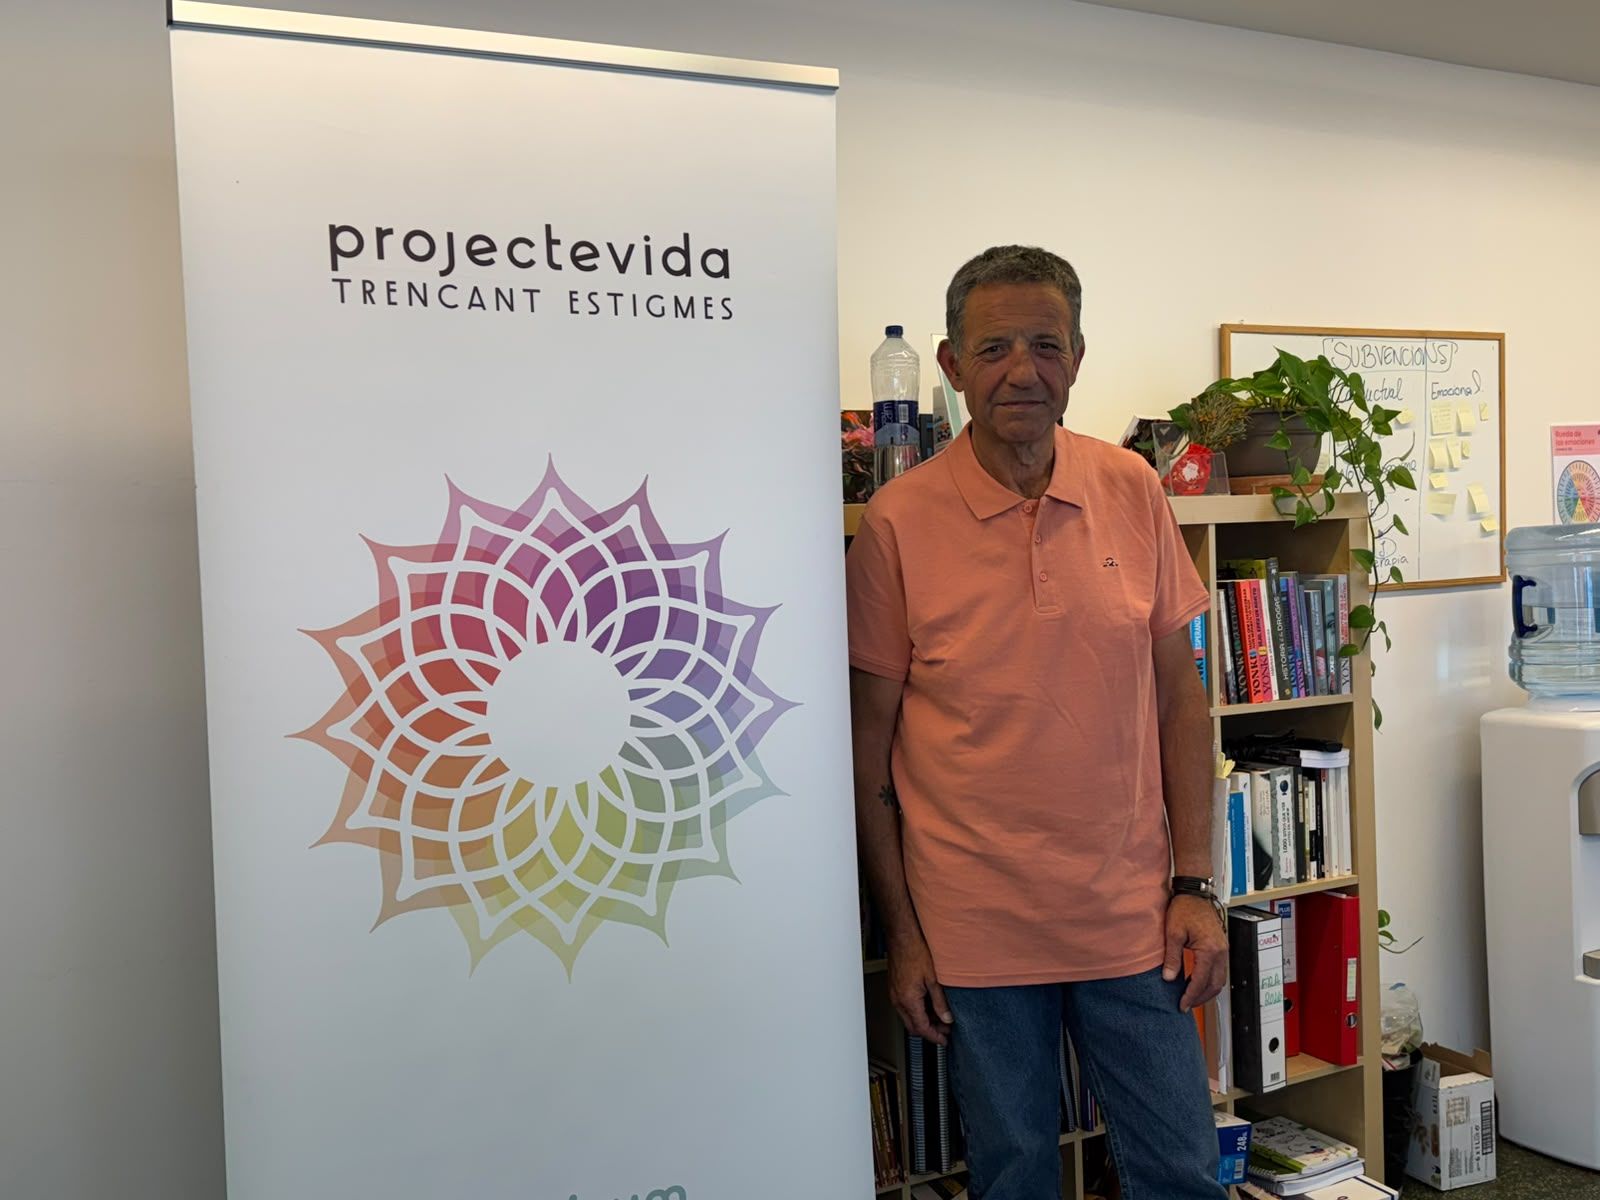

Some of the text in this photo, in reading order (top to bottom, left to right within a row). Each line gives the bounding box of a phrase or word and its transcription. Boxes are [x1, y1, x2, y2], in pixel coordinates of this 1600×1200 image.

[328, 223, 731, 279] projectevida
[331, 278, 734, 320] TRENCANT ESTIGMES
[1330, 341, 1448, 371] SUBVENCIONS
[1274, 596, 1283, 632] DROGAS
[1236, 650, 1248, 697] YONKI
[1249, 655, 1261, 696] YONKI
[1259, 655, 1271, 694] YONKI
[1279, 642, 1289, 681] HISTORIA
[1236, 1136, 1248, 1152] 248
